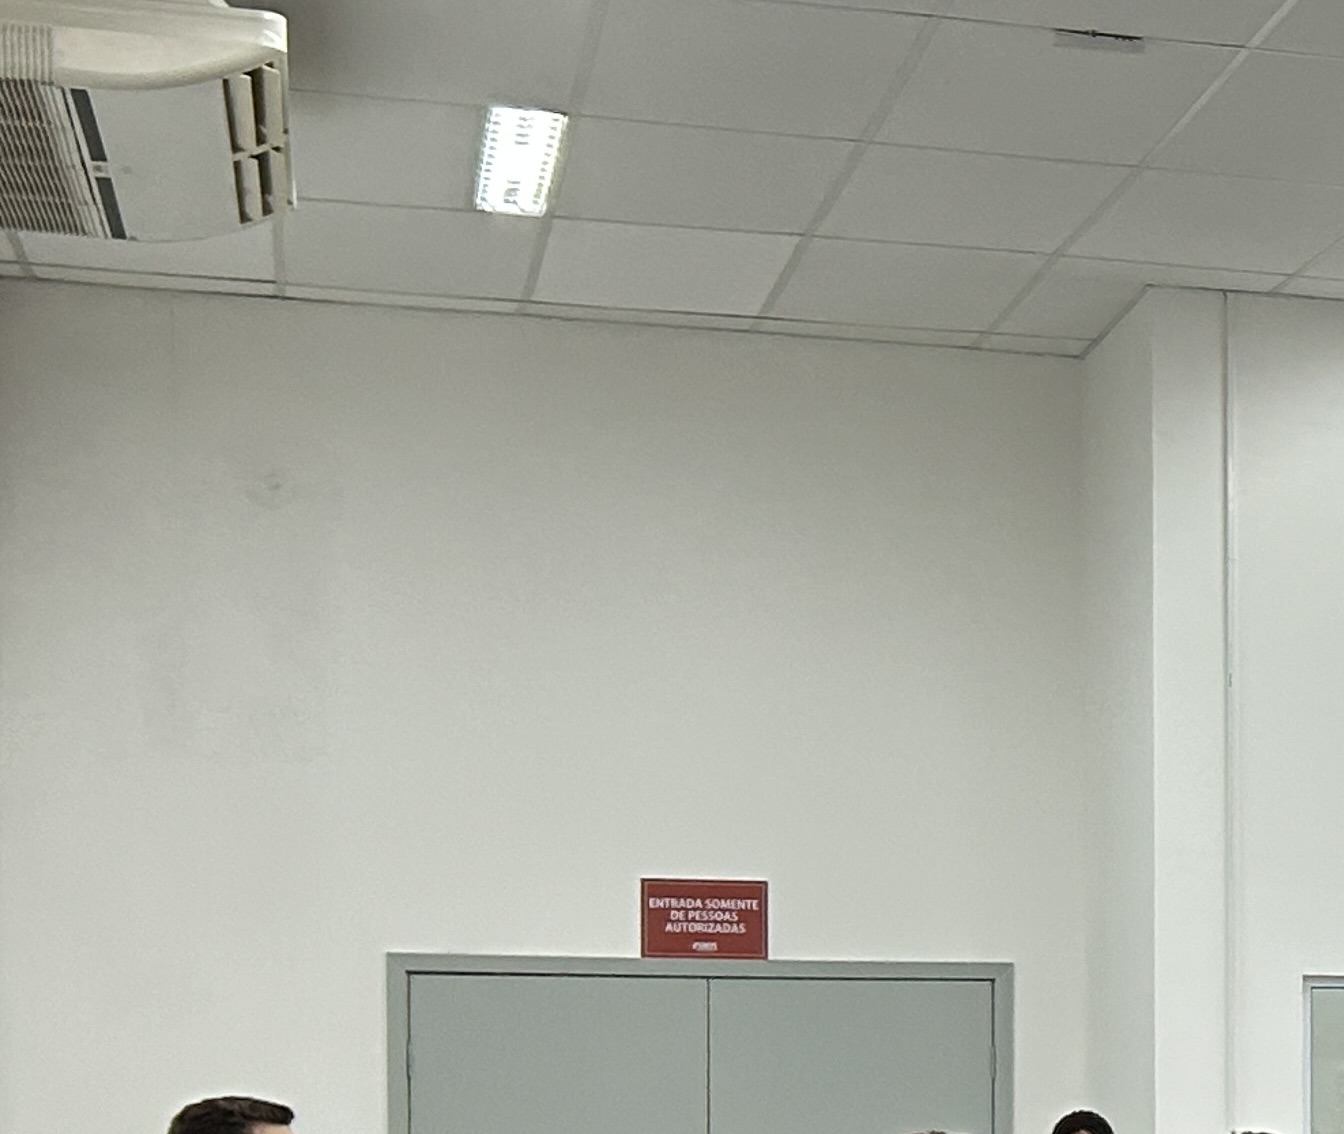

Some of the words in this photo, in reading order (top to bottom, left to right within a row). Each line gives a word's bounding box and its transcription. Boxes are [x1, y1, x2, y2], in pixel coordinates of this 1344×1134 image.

[648, 898, 702, 909] ENTRADA
[704, 899, 760, 911] SOMENTE
[670, 910, 686, 920] DE
[688, 911, 739, 922] PESSOAS
[665, 922, 747, 934] AUTORIZADAS
